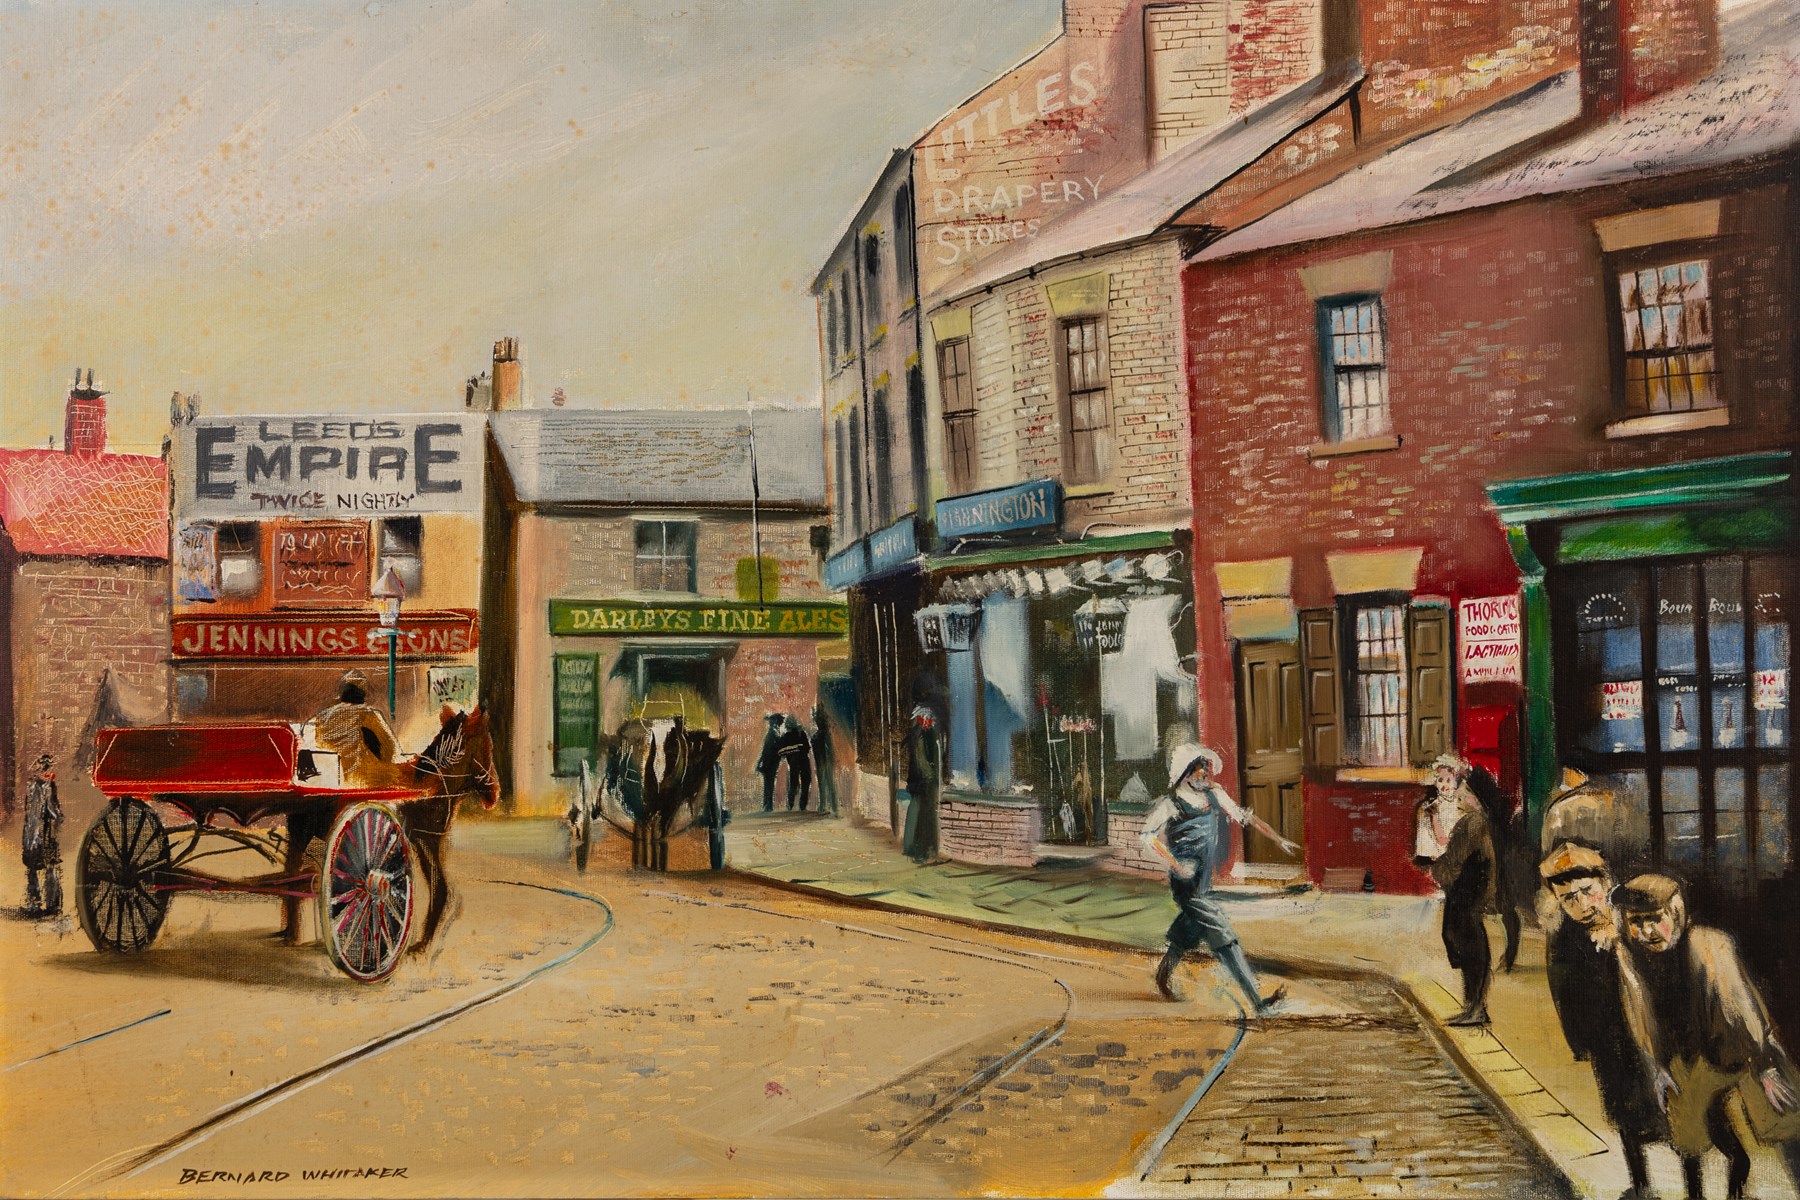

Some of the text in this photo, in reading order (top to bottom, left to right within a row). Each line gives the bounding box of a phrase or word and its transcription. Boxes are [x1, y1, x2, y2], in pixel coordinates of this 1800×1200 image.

[933, 175, 1104, 216] DRAPERY
[936, 219, 1041, 265] STORES
[258, 419, 405, 442] LEEDS
[195, 422, 463, 499] EMPIRE
[250, 490, 415, 511] TWICE NIGHTLY
[699, 608, 770, 632] FINE
[779, 608, 846, 633] ALES
[181, 622, 356, 653] JENNINGS
[178, 1167, 409, 1185] BERNARD WHITAKER
